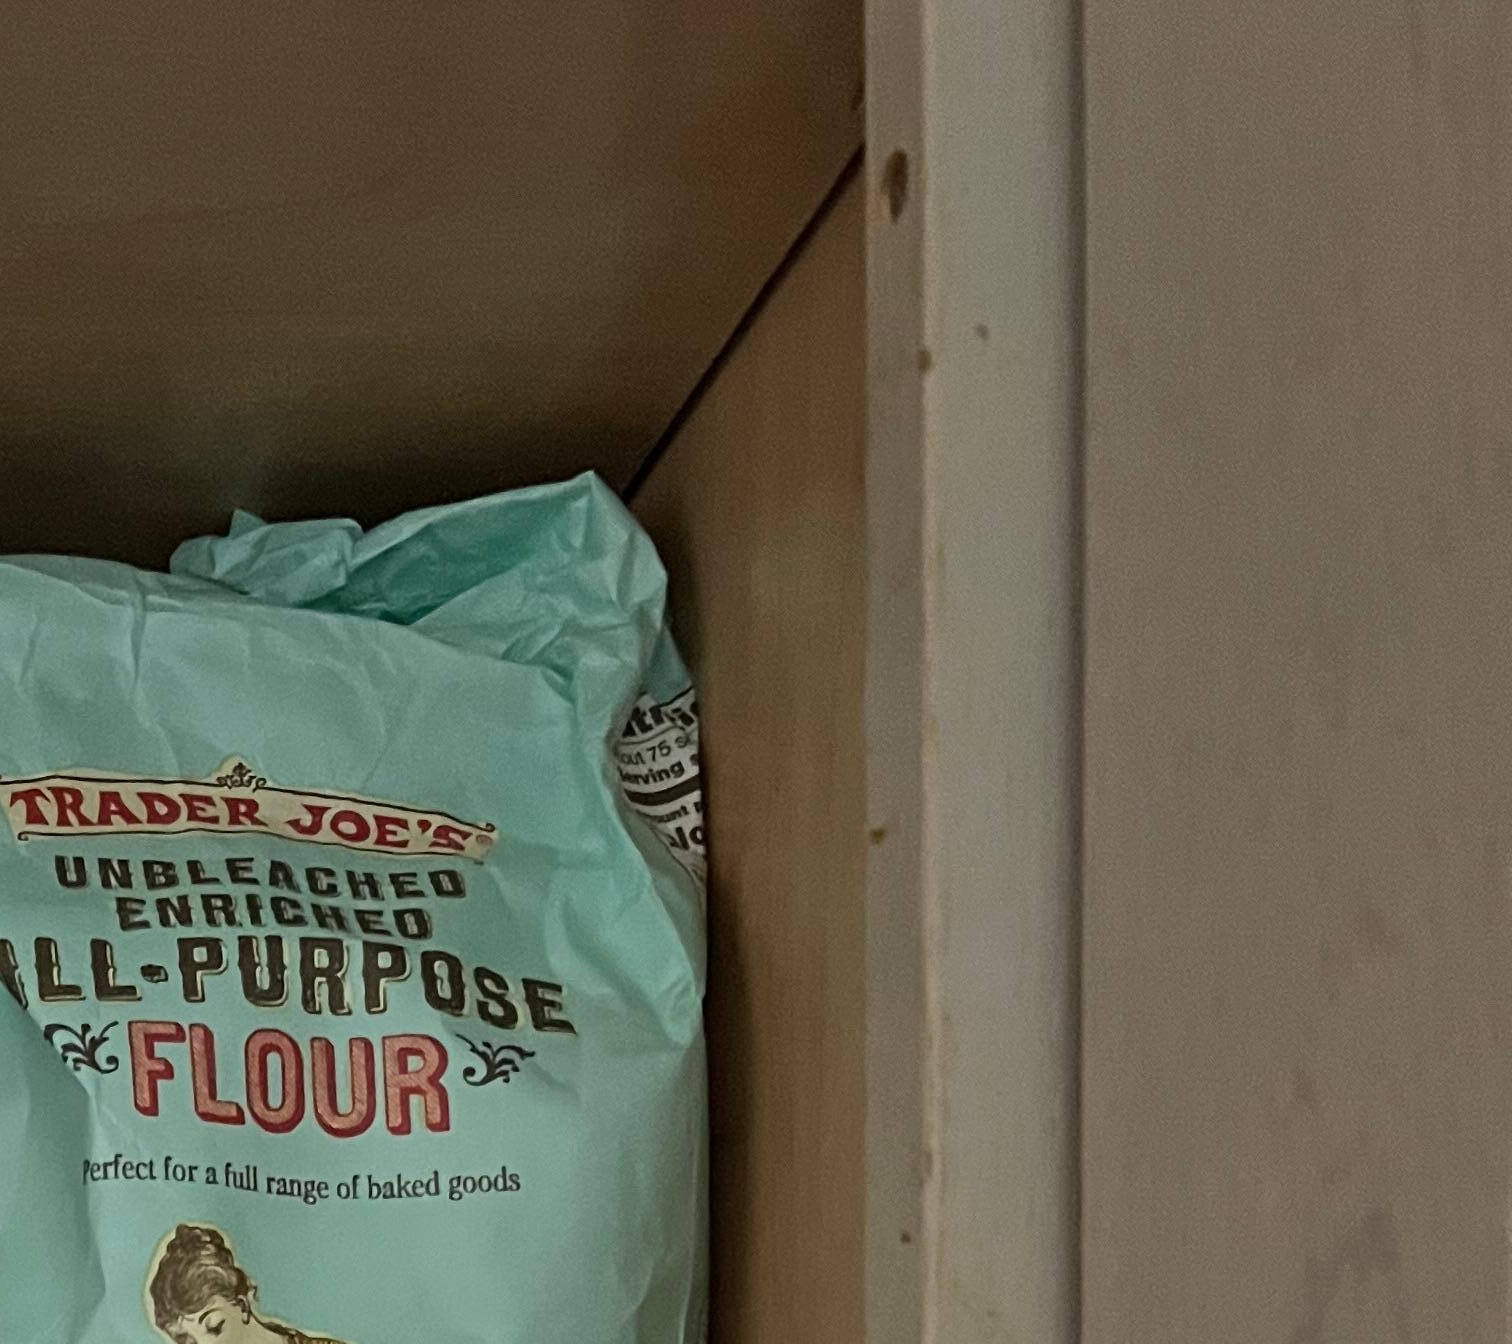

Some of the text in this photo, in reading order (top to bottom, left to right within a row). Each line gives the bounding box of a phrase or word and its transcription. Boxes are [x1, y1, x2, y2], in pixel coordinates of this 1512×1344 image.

[9, 785, 474, 852] TRADER JOE'S
[54, 854, 468, 900] UNBLEACHED
[114, 896, 432, 941] ENRICHED
[127, 1020, 452, 1139] FLOUR
[163, 1156, 198, 1185] for
[205, 1167, 220, 1187] a
[224, 1163, 258, 1193] full
[265, 1175, 330, 1205] range
[337, 1174, 360, 1201] of
[367, 1171, 441, 1200] baked
[448, 1166, 521, 1201] goods
